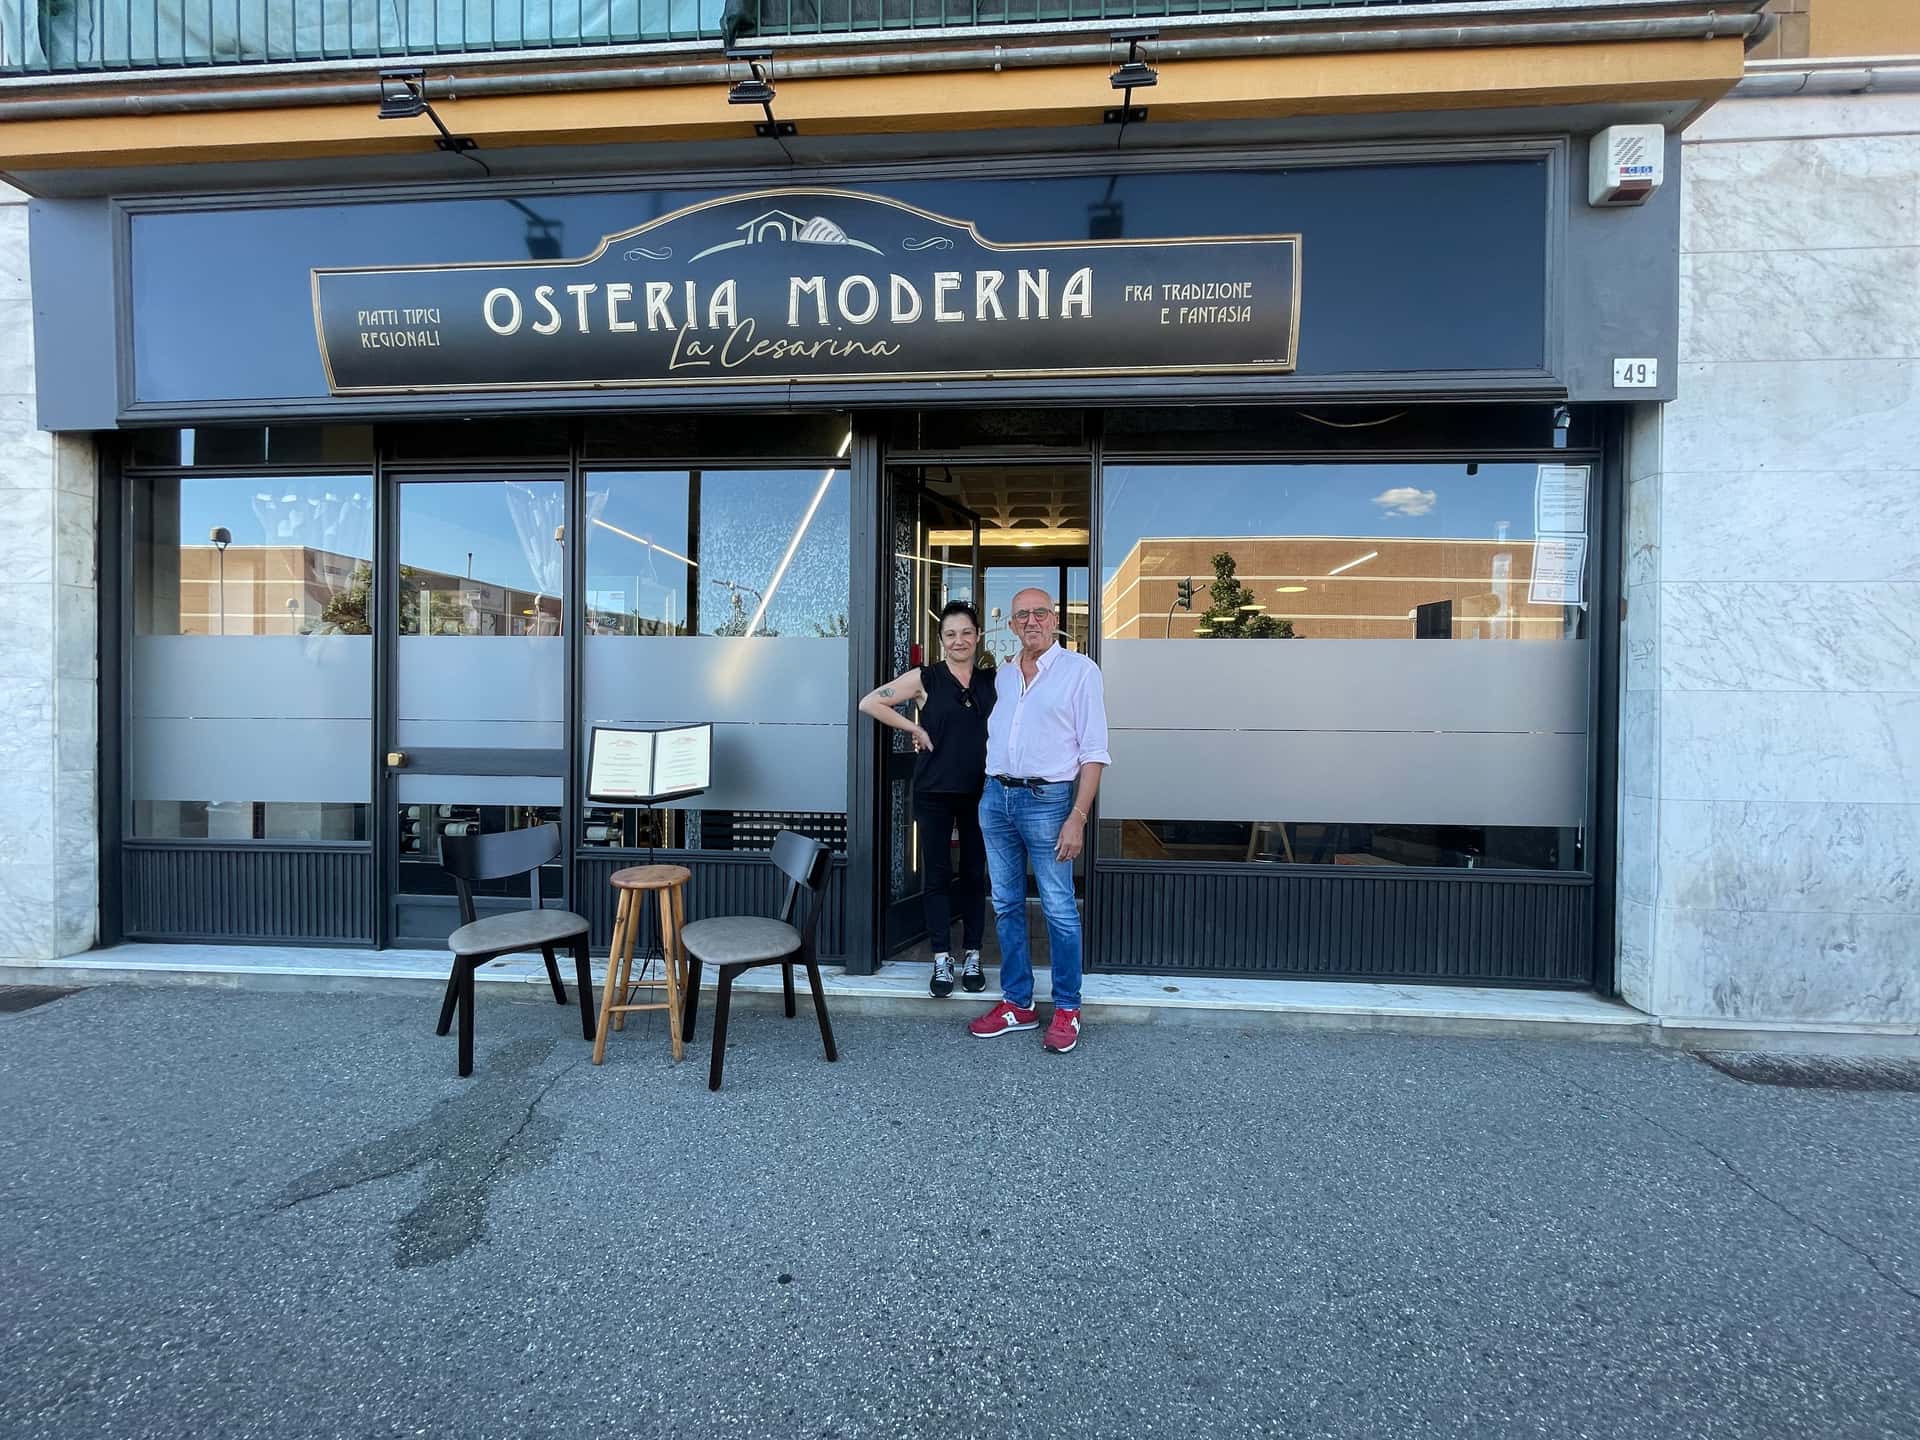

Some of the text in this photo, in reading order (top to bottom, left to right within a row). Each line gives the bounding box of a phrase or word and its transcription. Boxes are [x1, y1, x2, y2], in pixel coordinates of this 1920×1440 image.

[1125, 282, 1253, 301] FRA TRADIZIONE
[483, 267, 1094, 336] OSTERIA MODERNA
[358, 308, 441, 326] PIATTI TIPICI
[1161, 306, 1252, 324] E FANTASIA
[361, 330, 441, 348] REGIONALI
[668, 317, 901, 370] La Cesarina
[1623, 363, 1646, 384] 49
